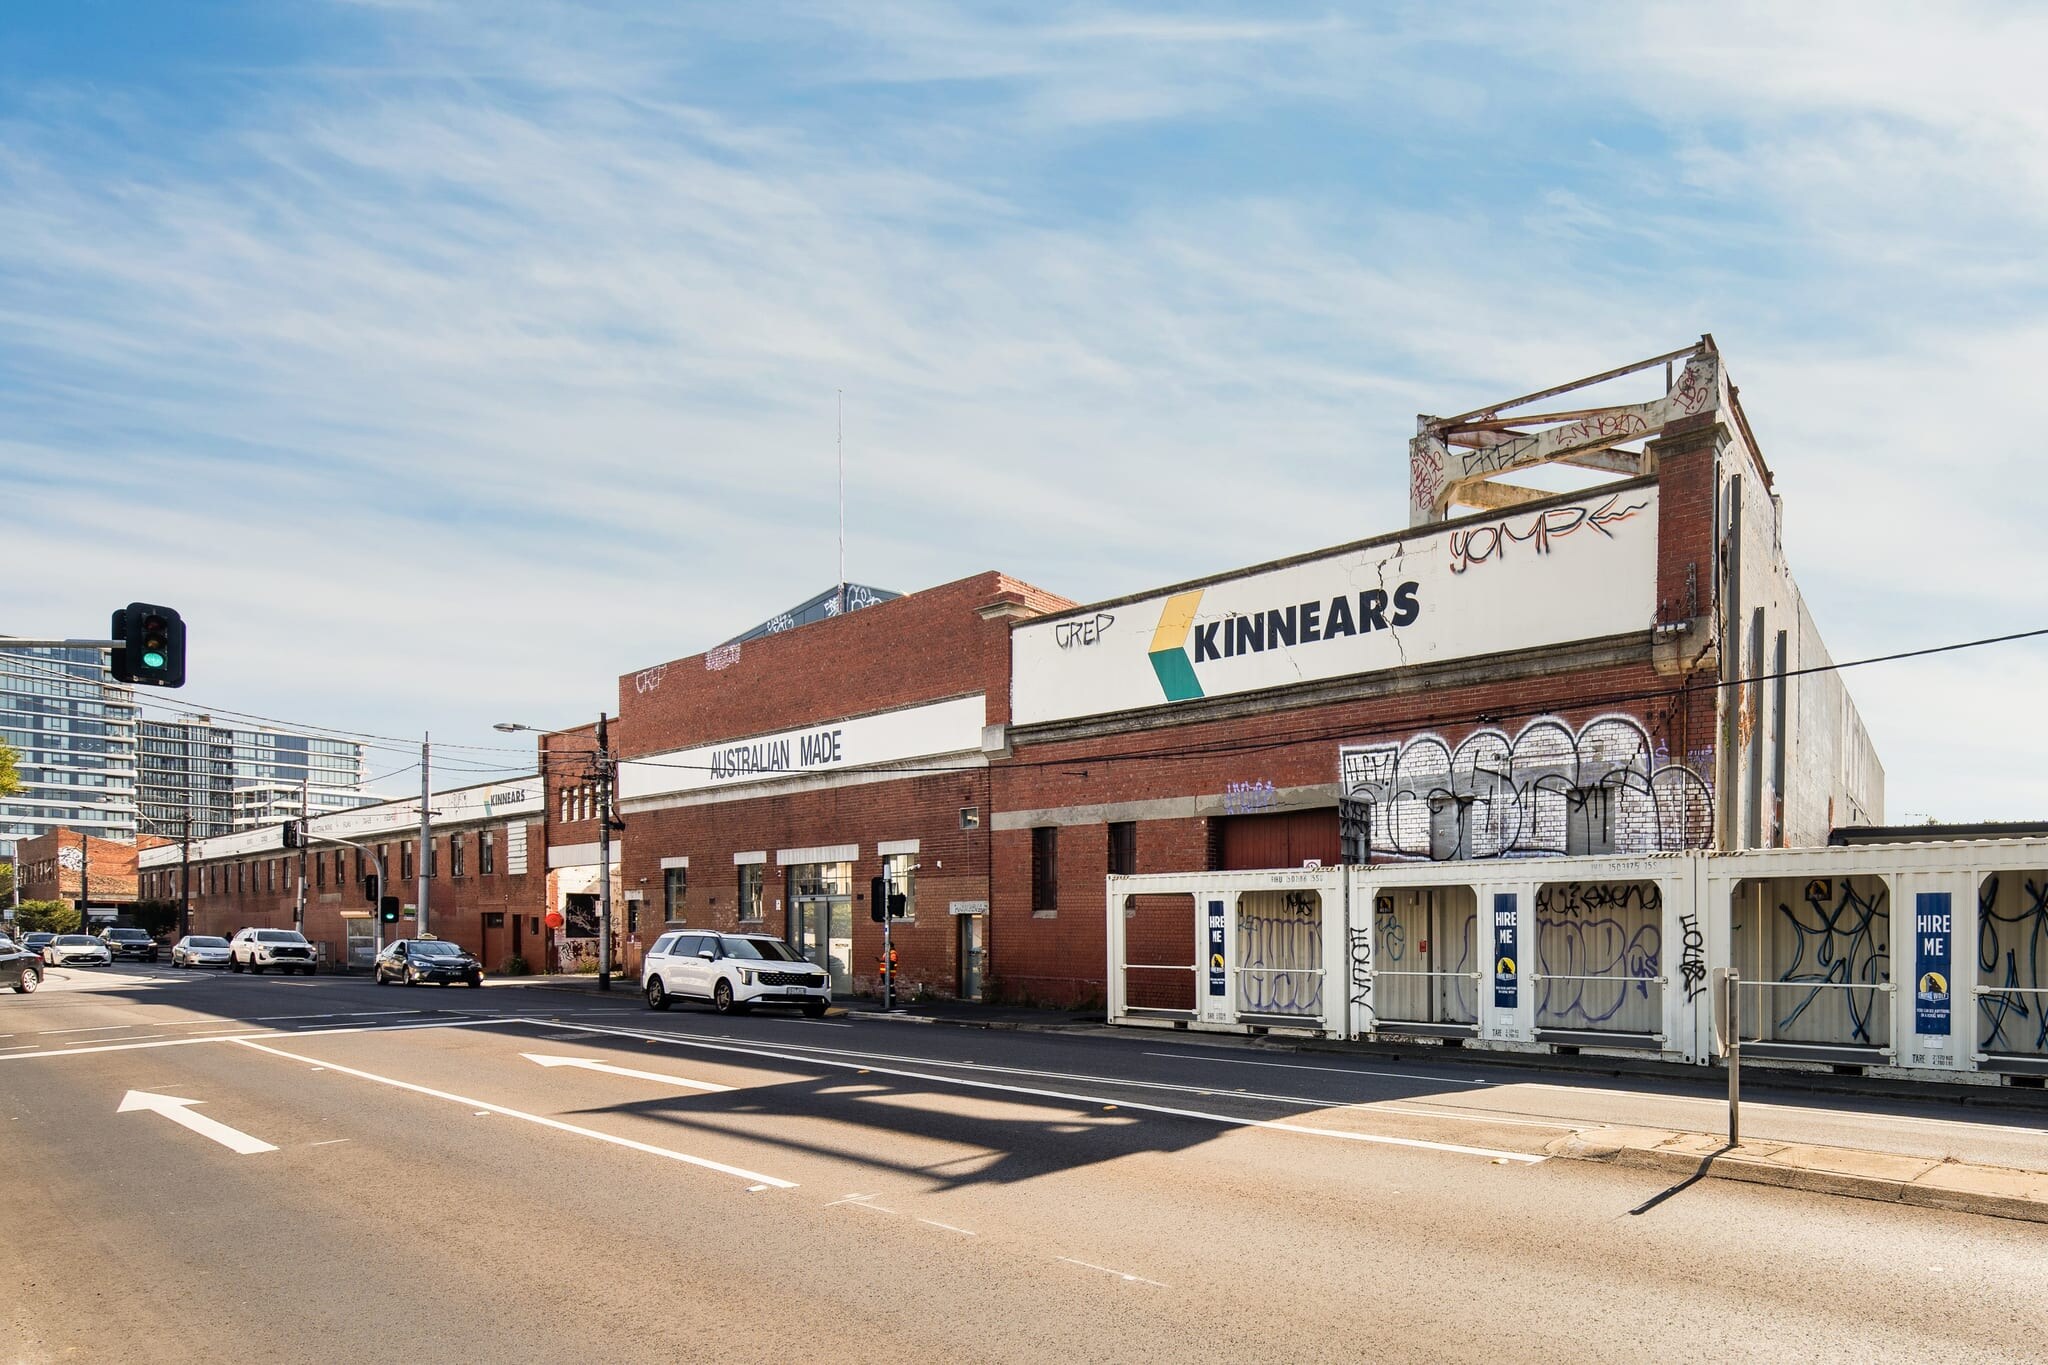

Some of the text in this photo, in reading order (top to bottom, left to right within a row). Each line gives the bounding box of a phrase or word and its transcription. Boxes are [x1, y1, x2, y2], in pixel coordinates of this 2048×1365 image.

[1194, 580, 1420, 664] KINNEARS
[710, 730, 842, 780] AUSTRALIAN MADE
[490, 789, 526, 807] KINNEARS
[1495, 911, 1517, 927] HIRE
[1917, 915, 1951, 933] HIRE
[1500, 929, 1513, 944] ME
[1923, 938, 1944, 956] ME
